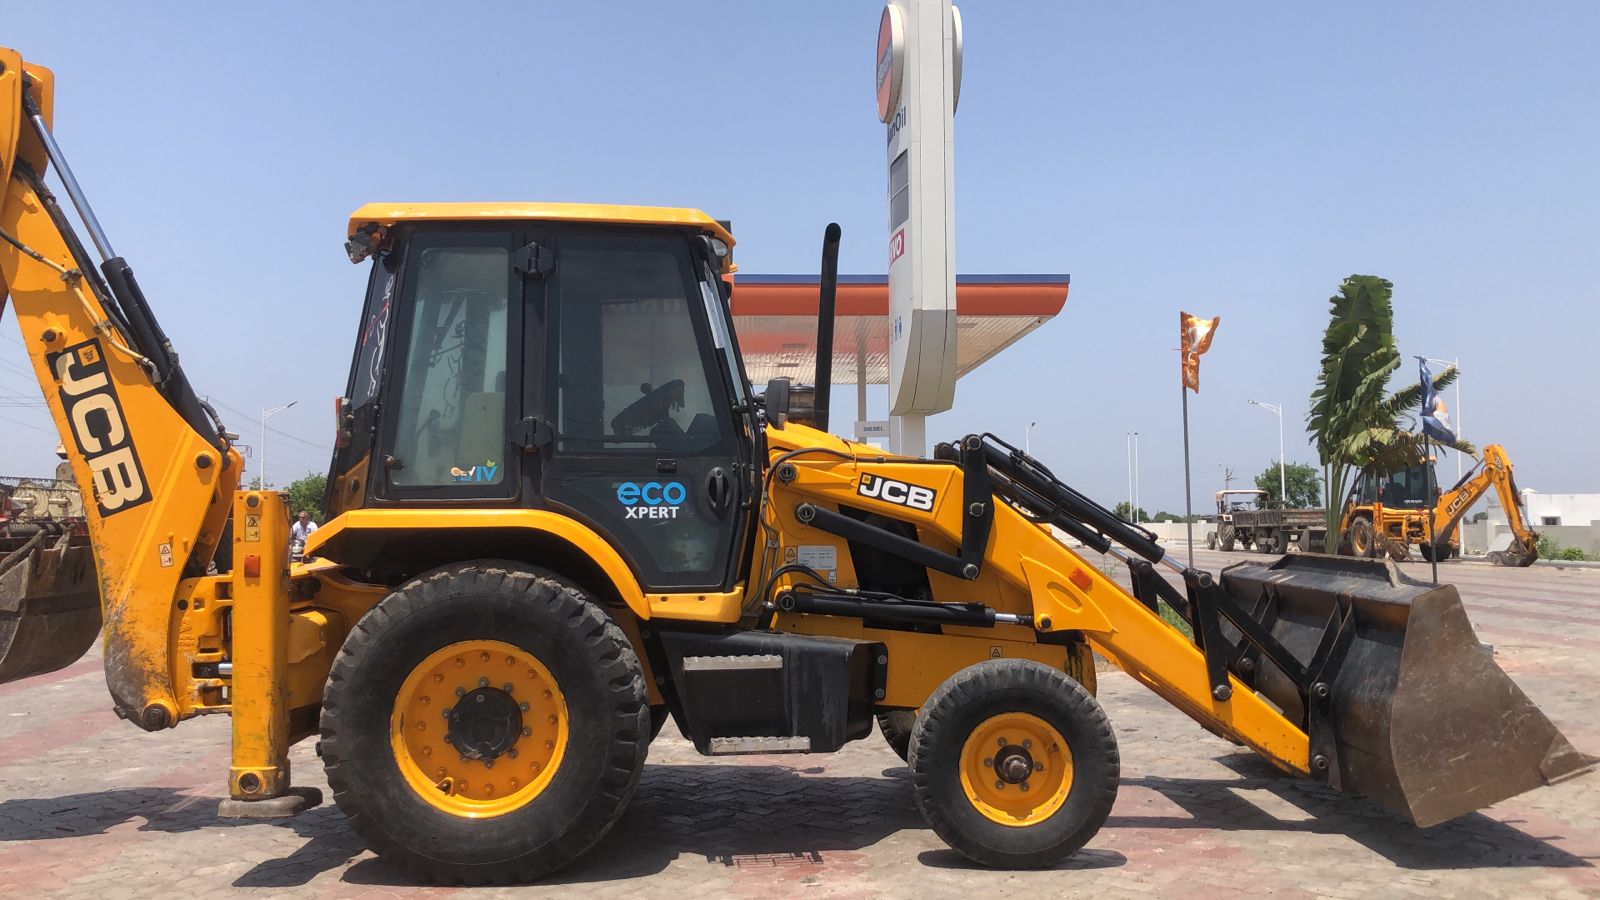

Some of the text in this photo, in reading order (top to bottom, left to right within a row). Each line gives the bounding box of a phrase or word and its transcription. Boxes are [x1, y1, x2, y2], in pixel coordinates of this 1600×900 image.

[56, 351, 143, 510] JCB
[476, 465, 497, 482] IV
[616, 481, 687, 505] eco
[859, 477, 934, 510] JCB
[1448, 490, 1470, 515] JCB
[624, 506, 680, 519] XPERT
